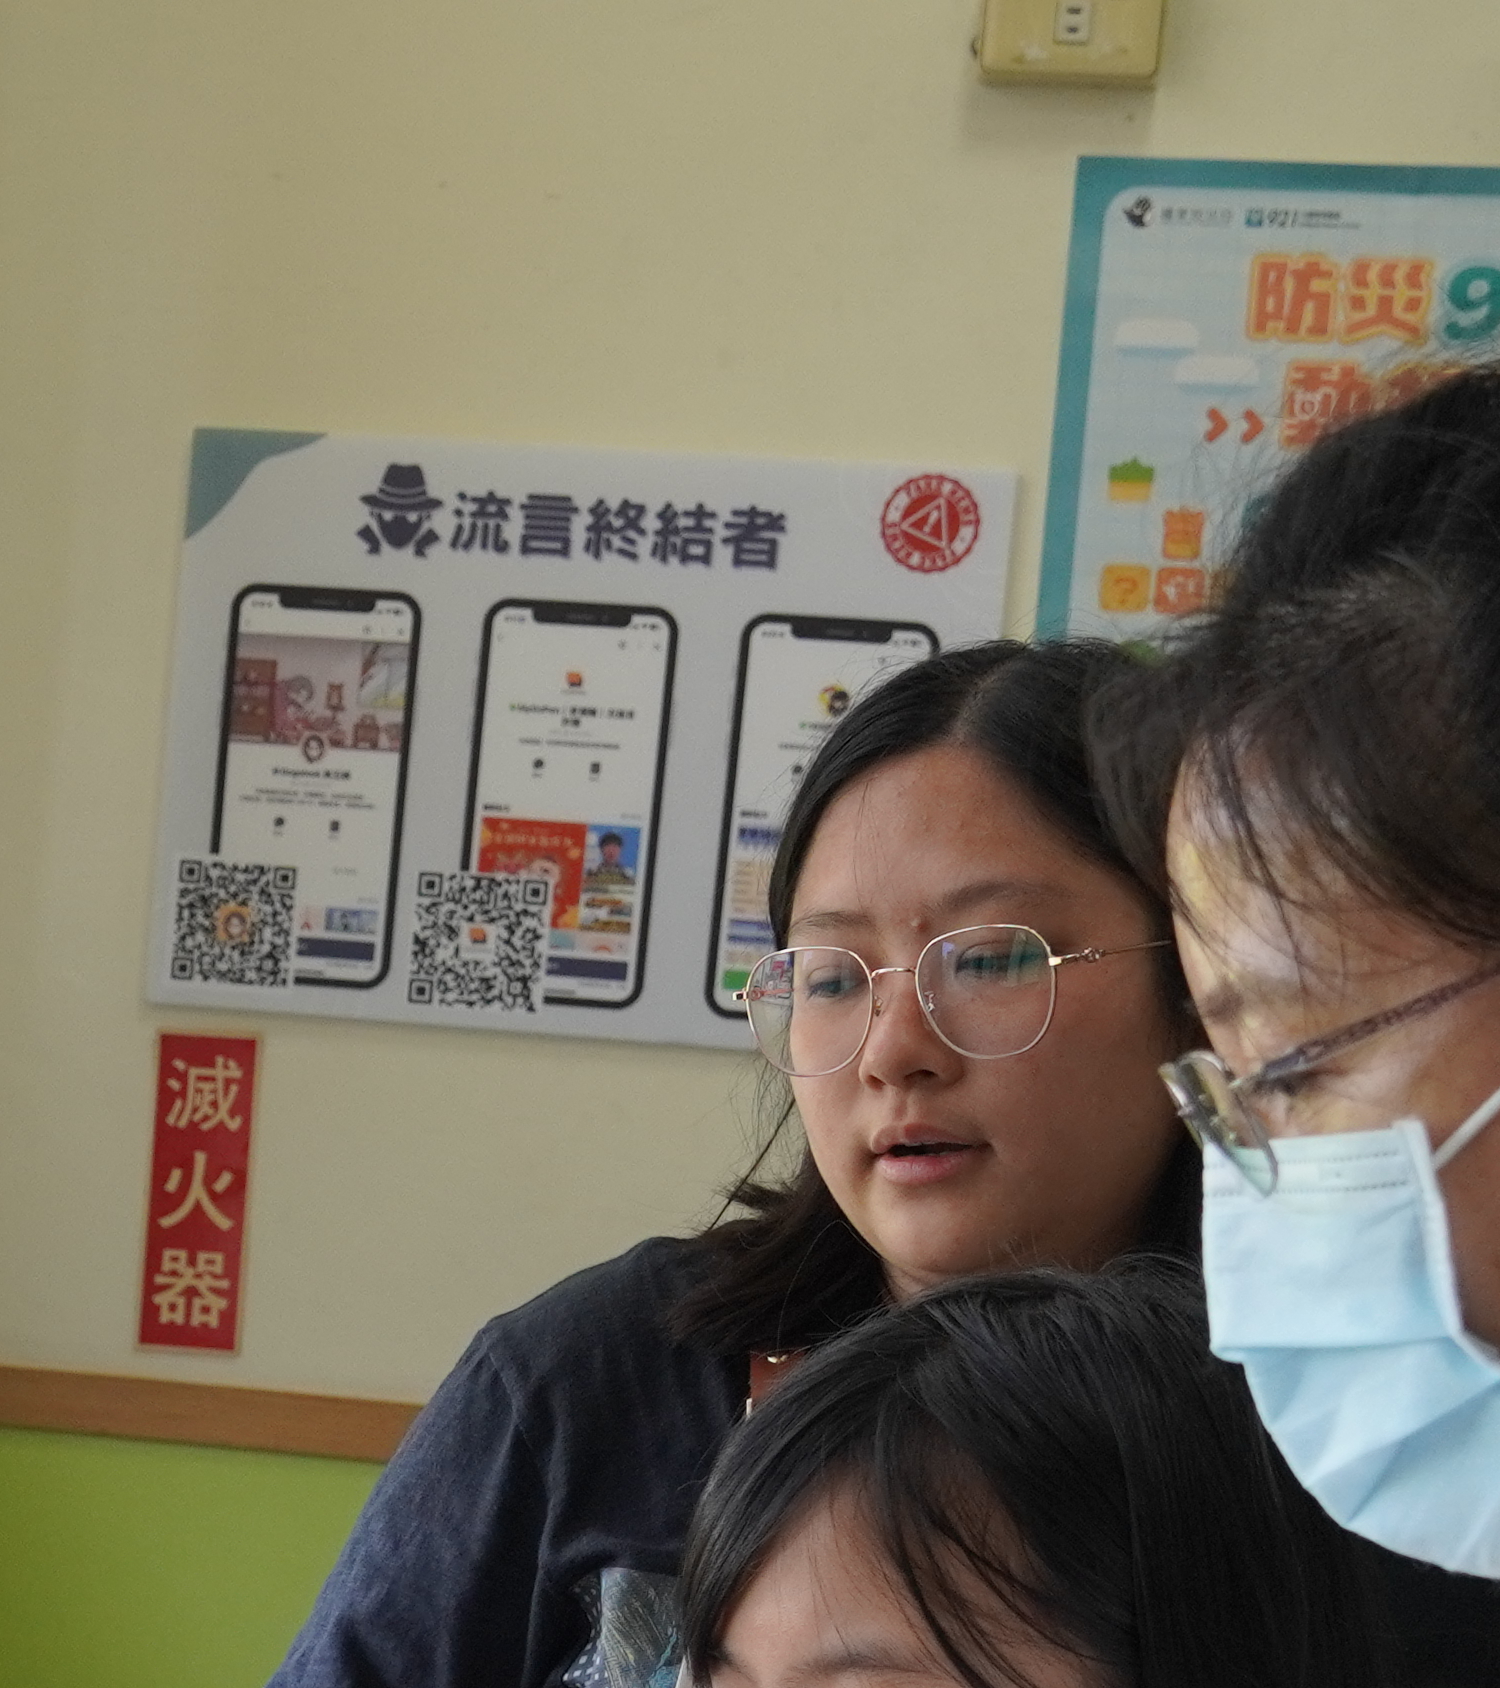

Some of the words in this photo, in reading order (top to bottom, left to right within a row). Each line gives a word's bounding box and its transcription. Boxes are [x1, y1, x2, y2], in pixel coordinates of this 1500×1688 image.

[451, 490, 787, 571] 流言終結者
[152, 1055, 243, 1329] 滅火器
